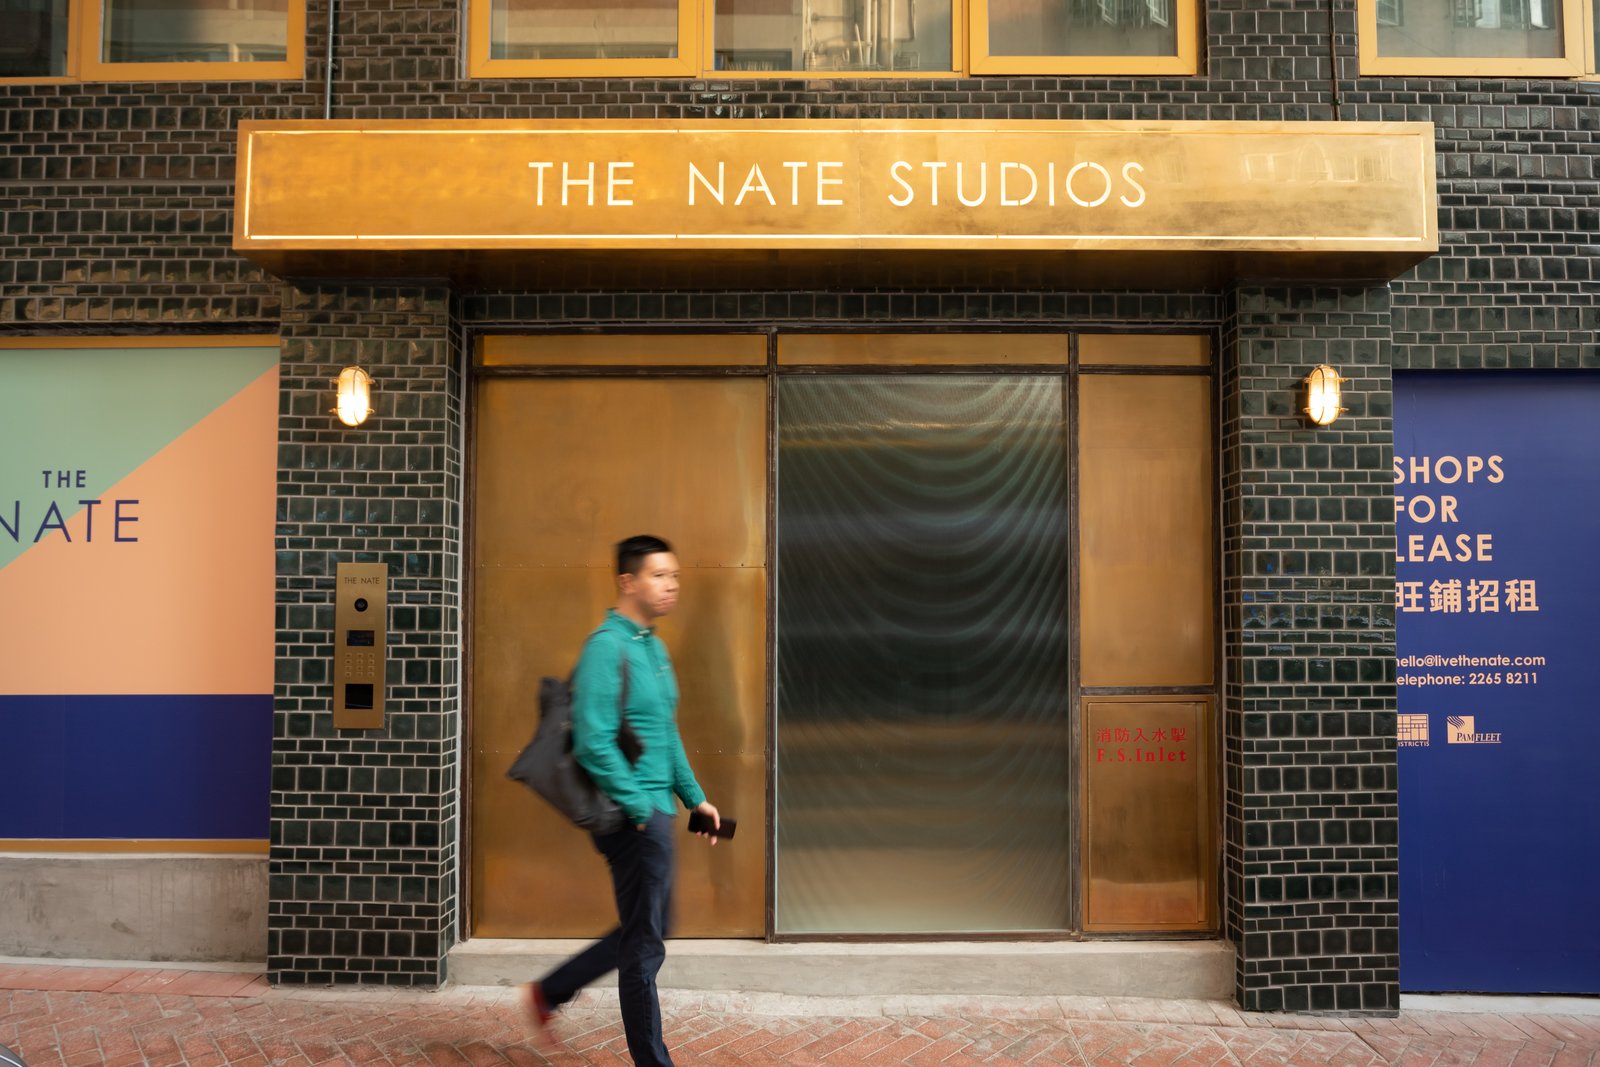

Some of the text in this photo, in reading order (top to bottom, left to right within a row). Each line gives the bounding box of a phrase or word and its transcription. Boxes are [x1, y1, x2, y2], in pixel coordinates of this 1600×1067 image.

[528, 161, 1147, 208] THE NATE STUDIOS
[42, 470, 86, 488] THE
[1393, 455, 1504, 484] SHOPS
[1394, 495, 1459, 523] FOR
[344, 576, 380, 585] THE NATE
[1395, 578, 1540, 613] 旺鋪招租
[1396, 672, 1537, 688] elephone: 2265 8211
[1097, 747, 1186, 763] F.S.Inlet
